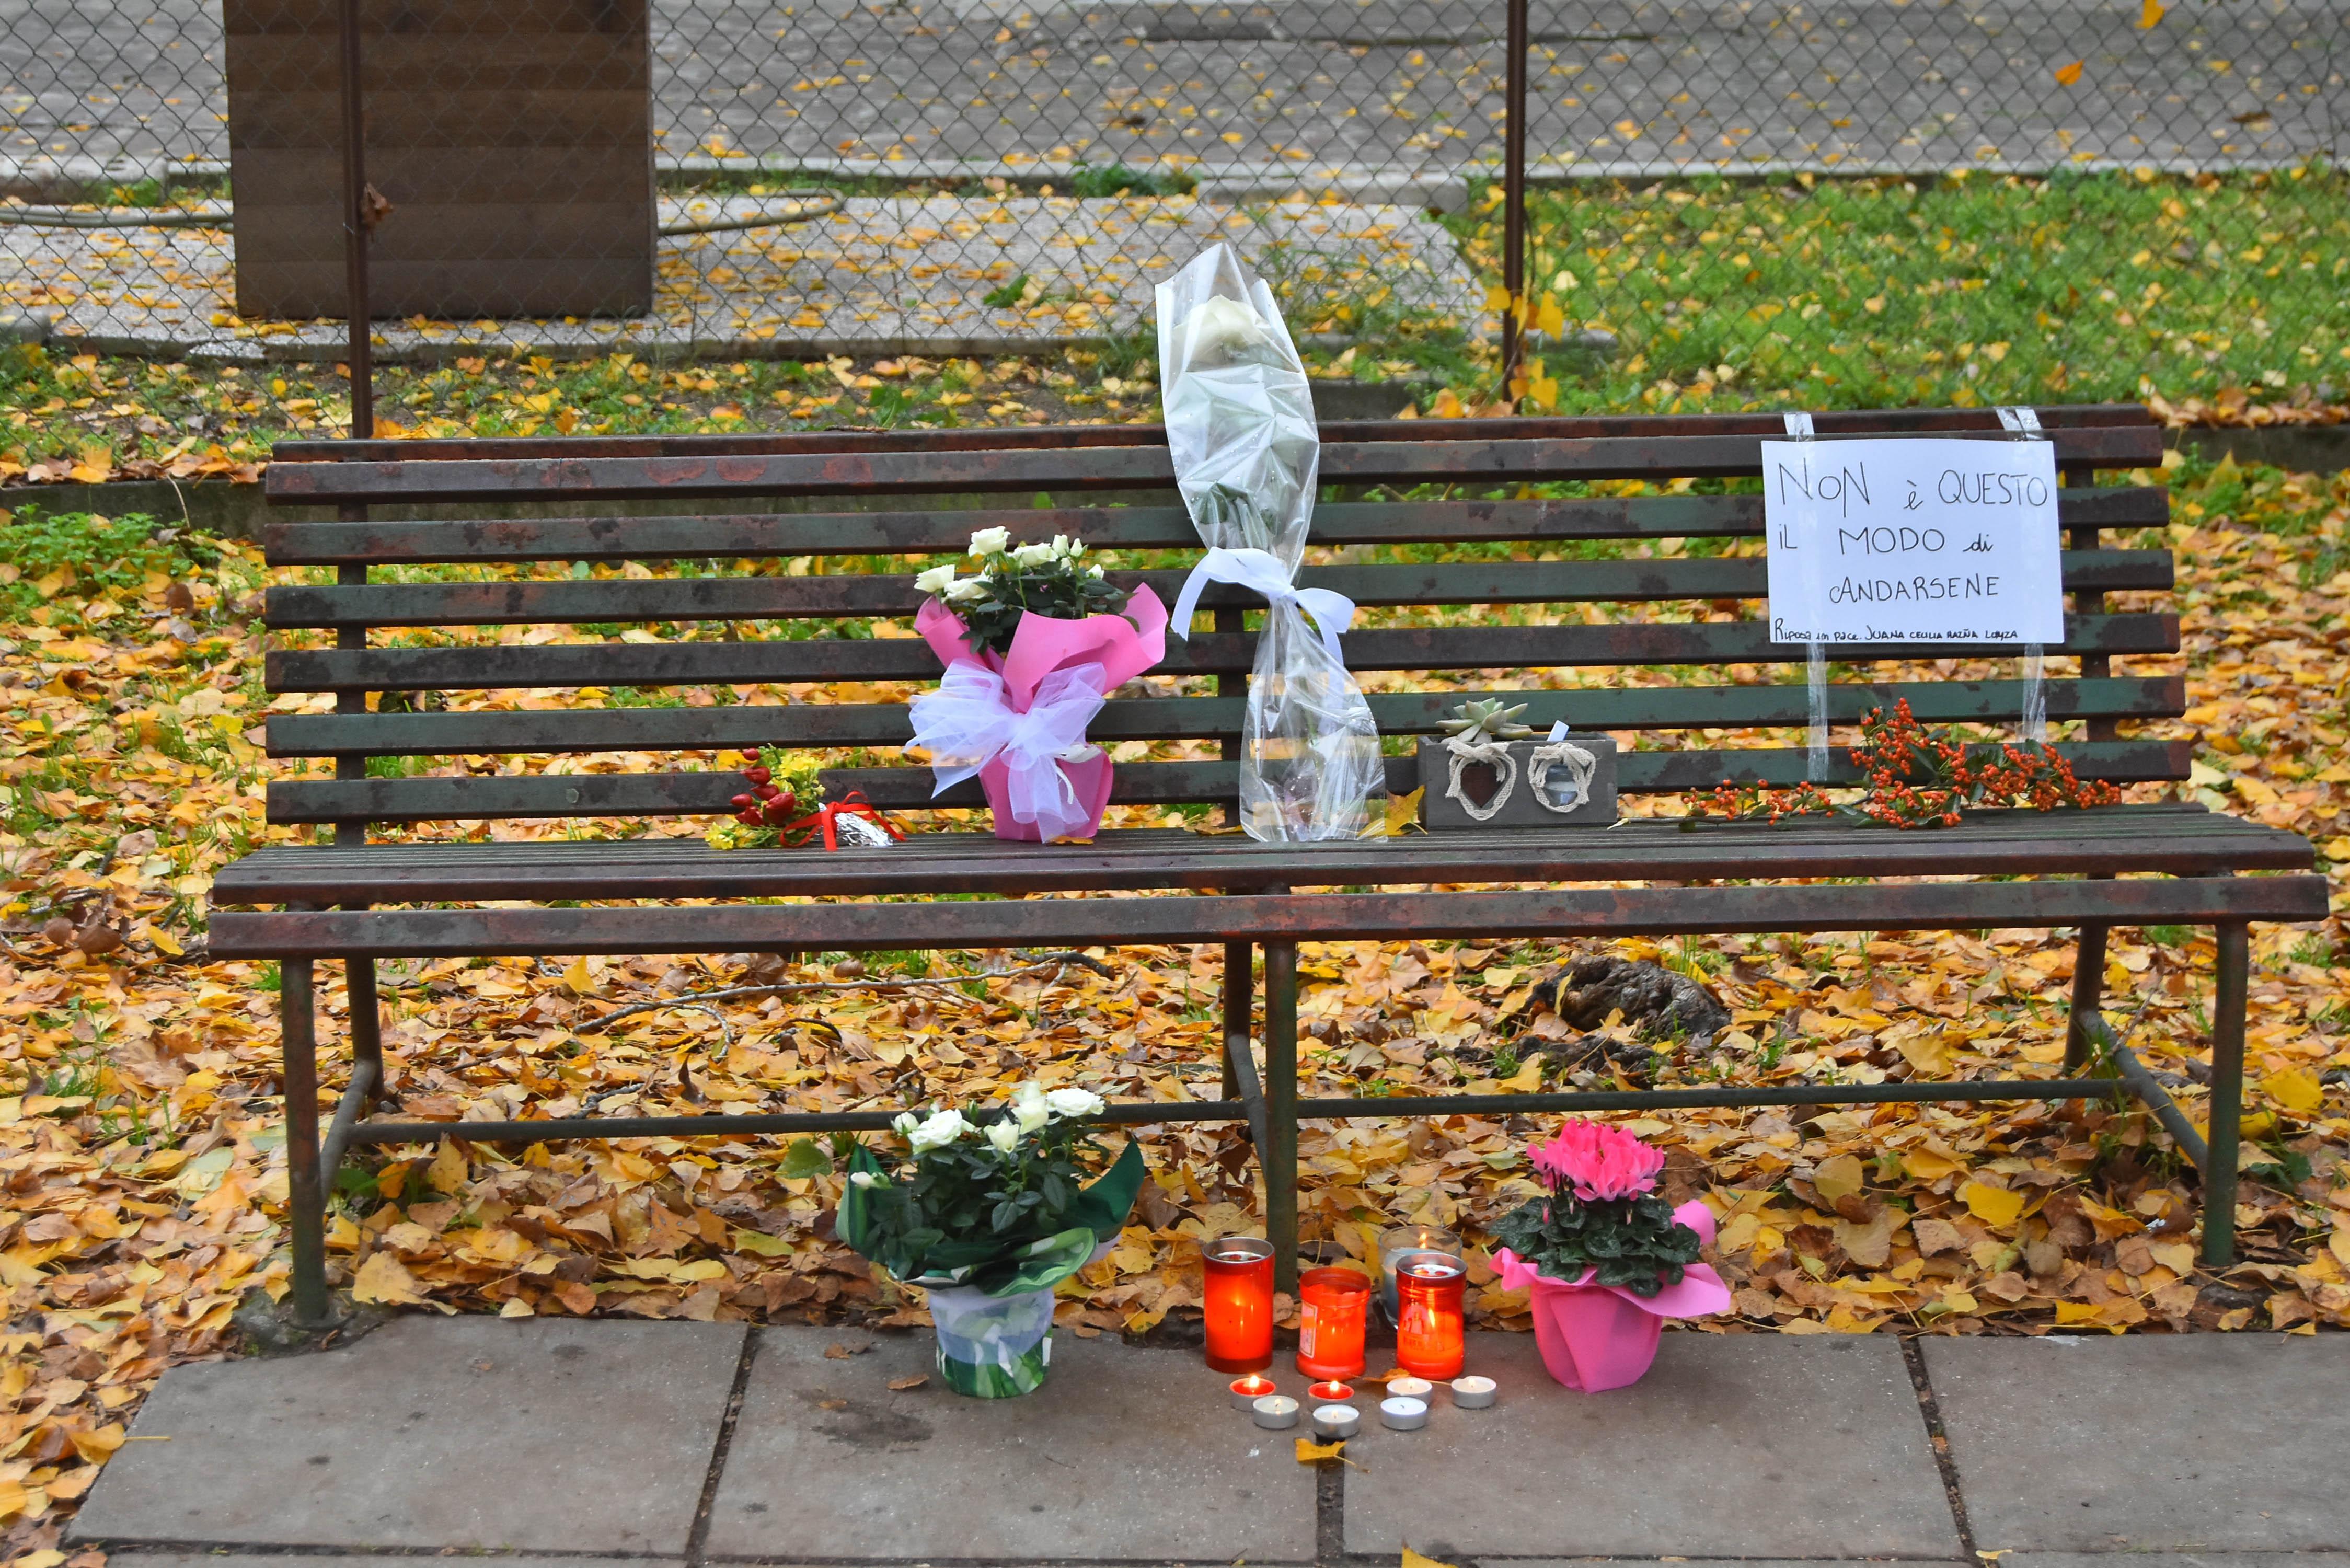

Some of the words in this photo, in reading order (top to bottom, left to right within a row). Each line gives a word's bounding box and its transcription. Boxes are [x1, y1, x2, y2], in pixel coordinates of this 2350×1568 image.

[1903, 479, 1923, 511] è
[1938, 469, 2048, 507] QUESTO
[1838, 526, 1945, 555] MODO
[1962, 532, 1994, 552] di
[1829, 572, 2000, 604] ANDARSENE
[1774, 617, 1812, 641] Riposa
[1815, 629, 1830, 640] in
[1864, 624, 1905, 641] JUANA
